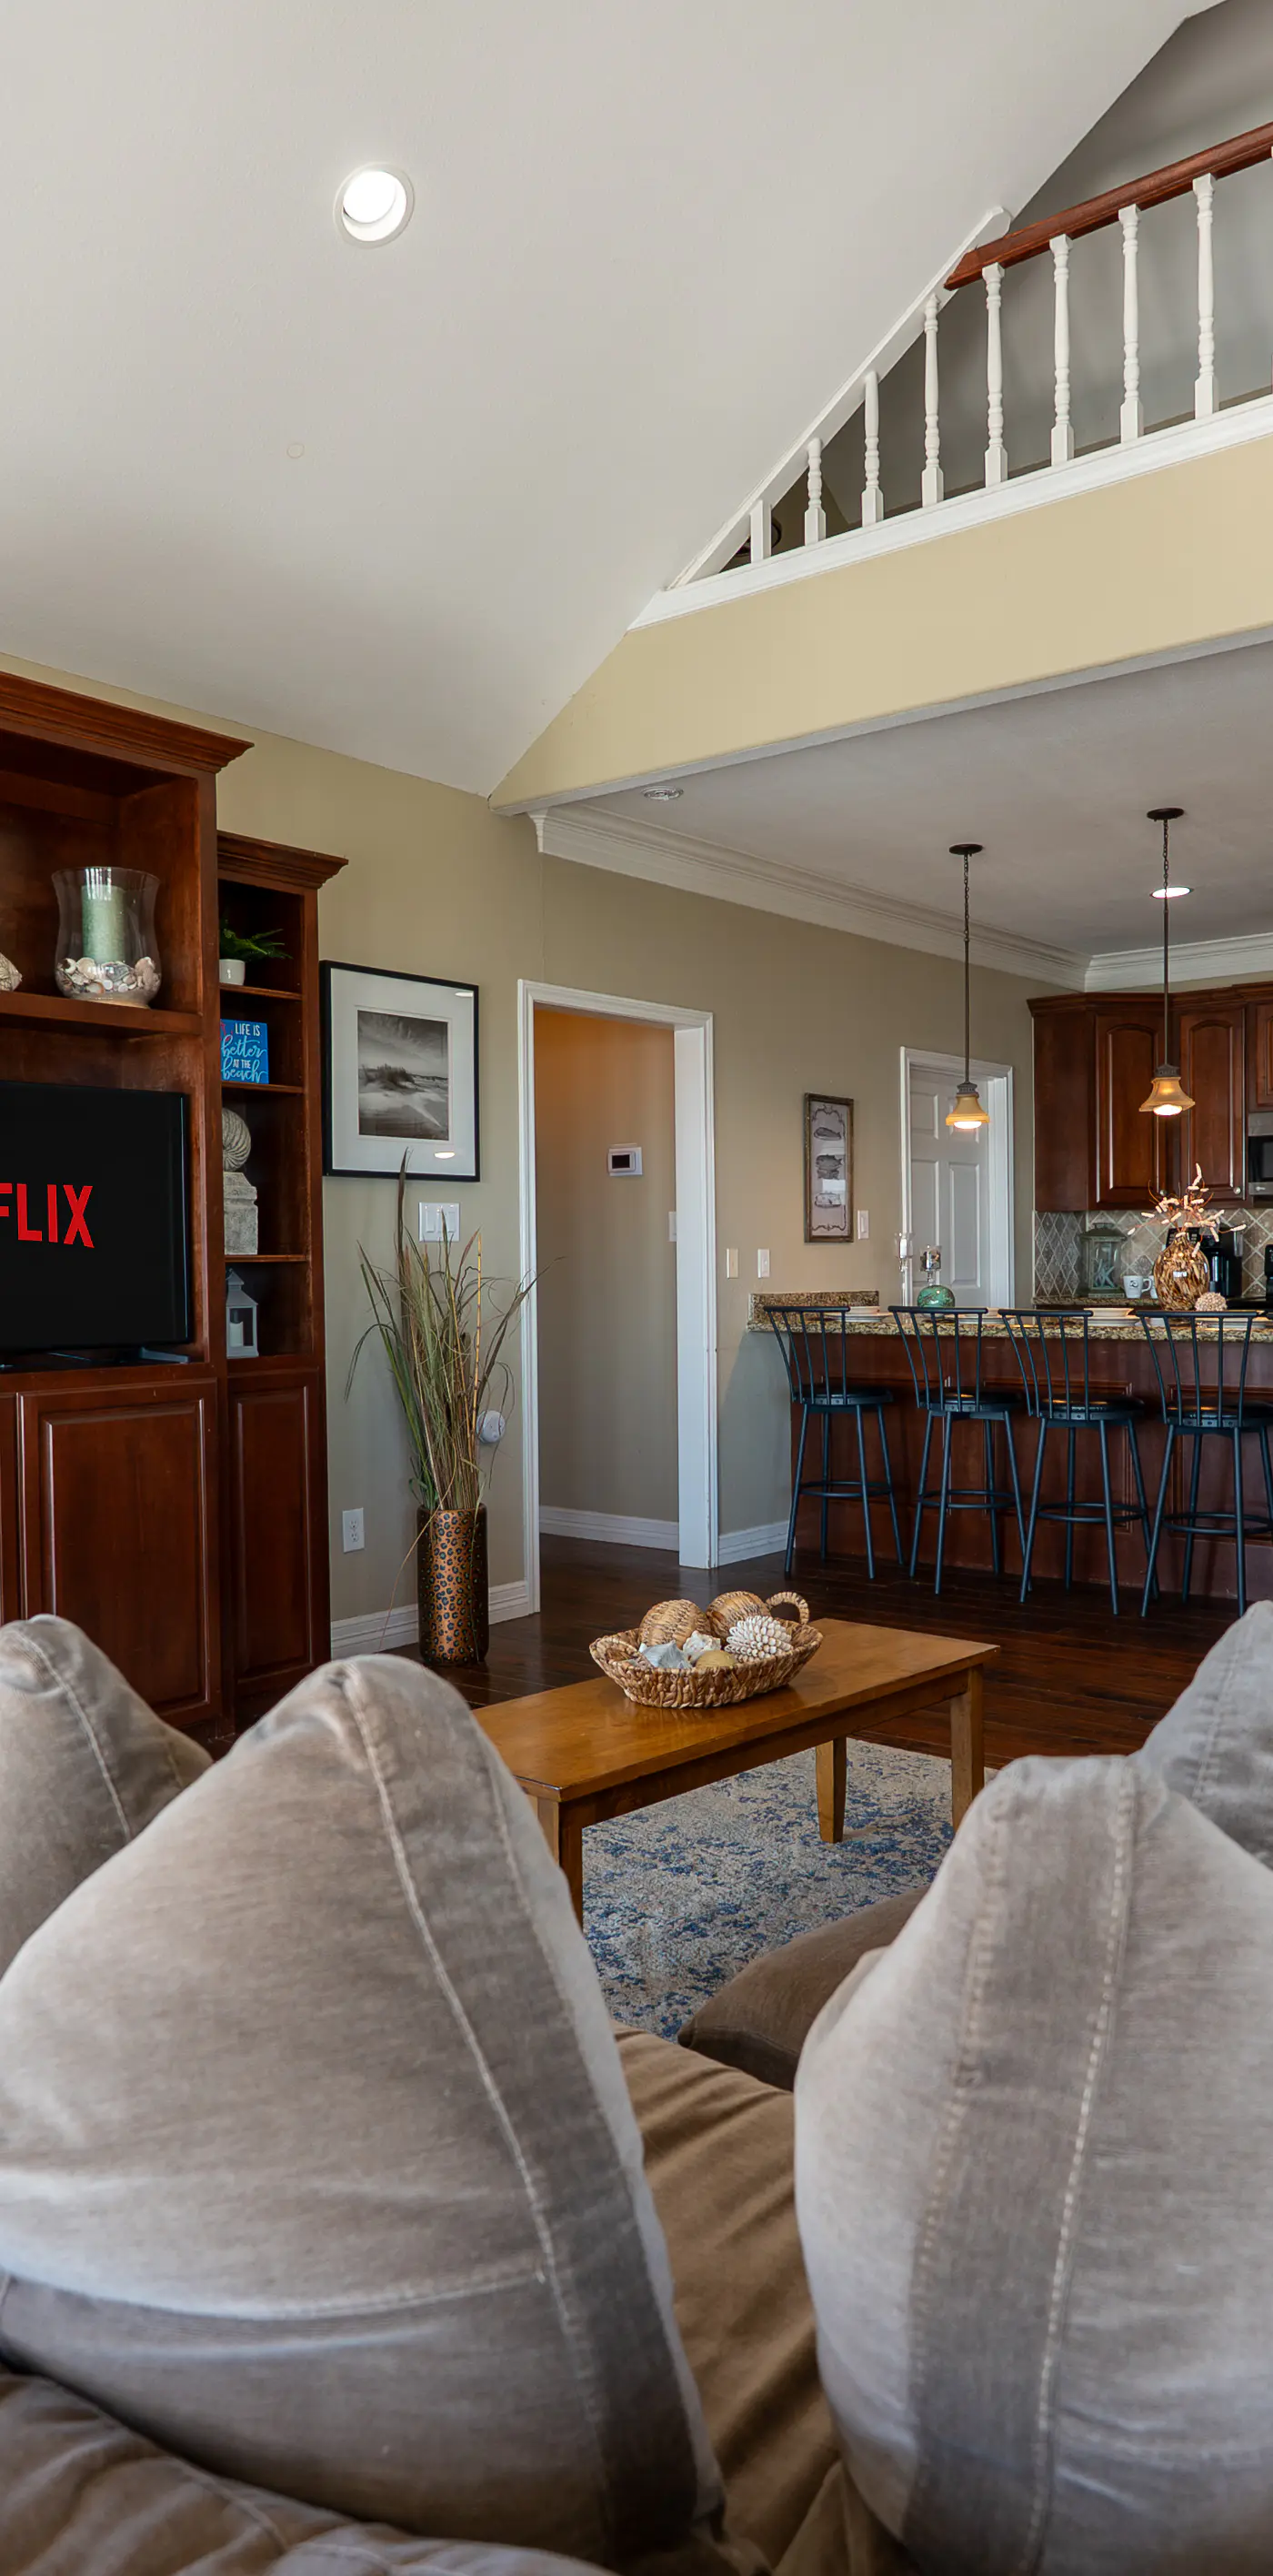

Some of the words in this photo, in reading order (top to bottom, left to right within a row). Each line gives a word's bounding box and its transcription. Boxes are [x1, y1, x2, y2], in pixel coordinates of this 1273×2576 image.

[235, 1022, 251, 1035] LIFE
[253, 1024, 261, 1037] IS
[221, 1034, 267, 1058] better
[221, 1055, 268, 1083] beach
[233, 1059, 240, 1069] AT
[241, 1059, 251, 1069] THE
